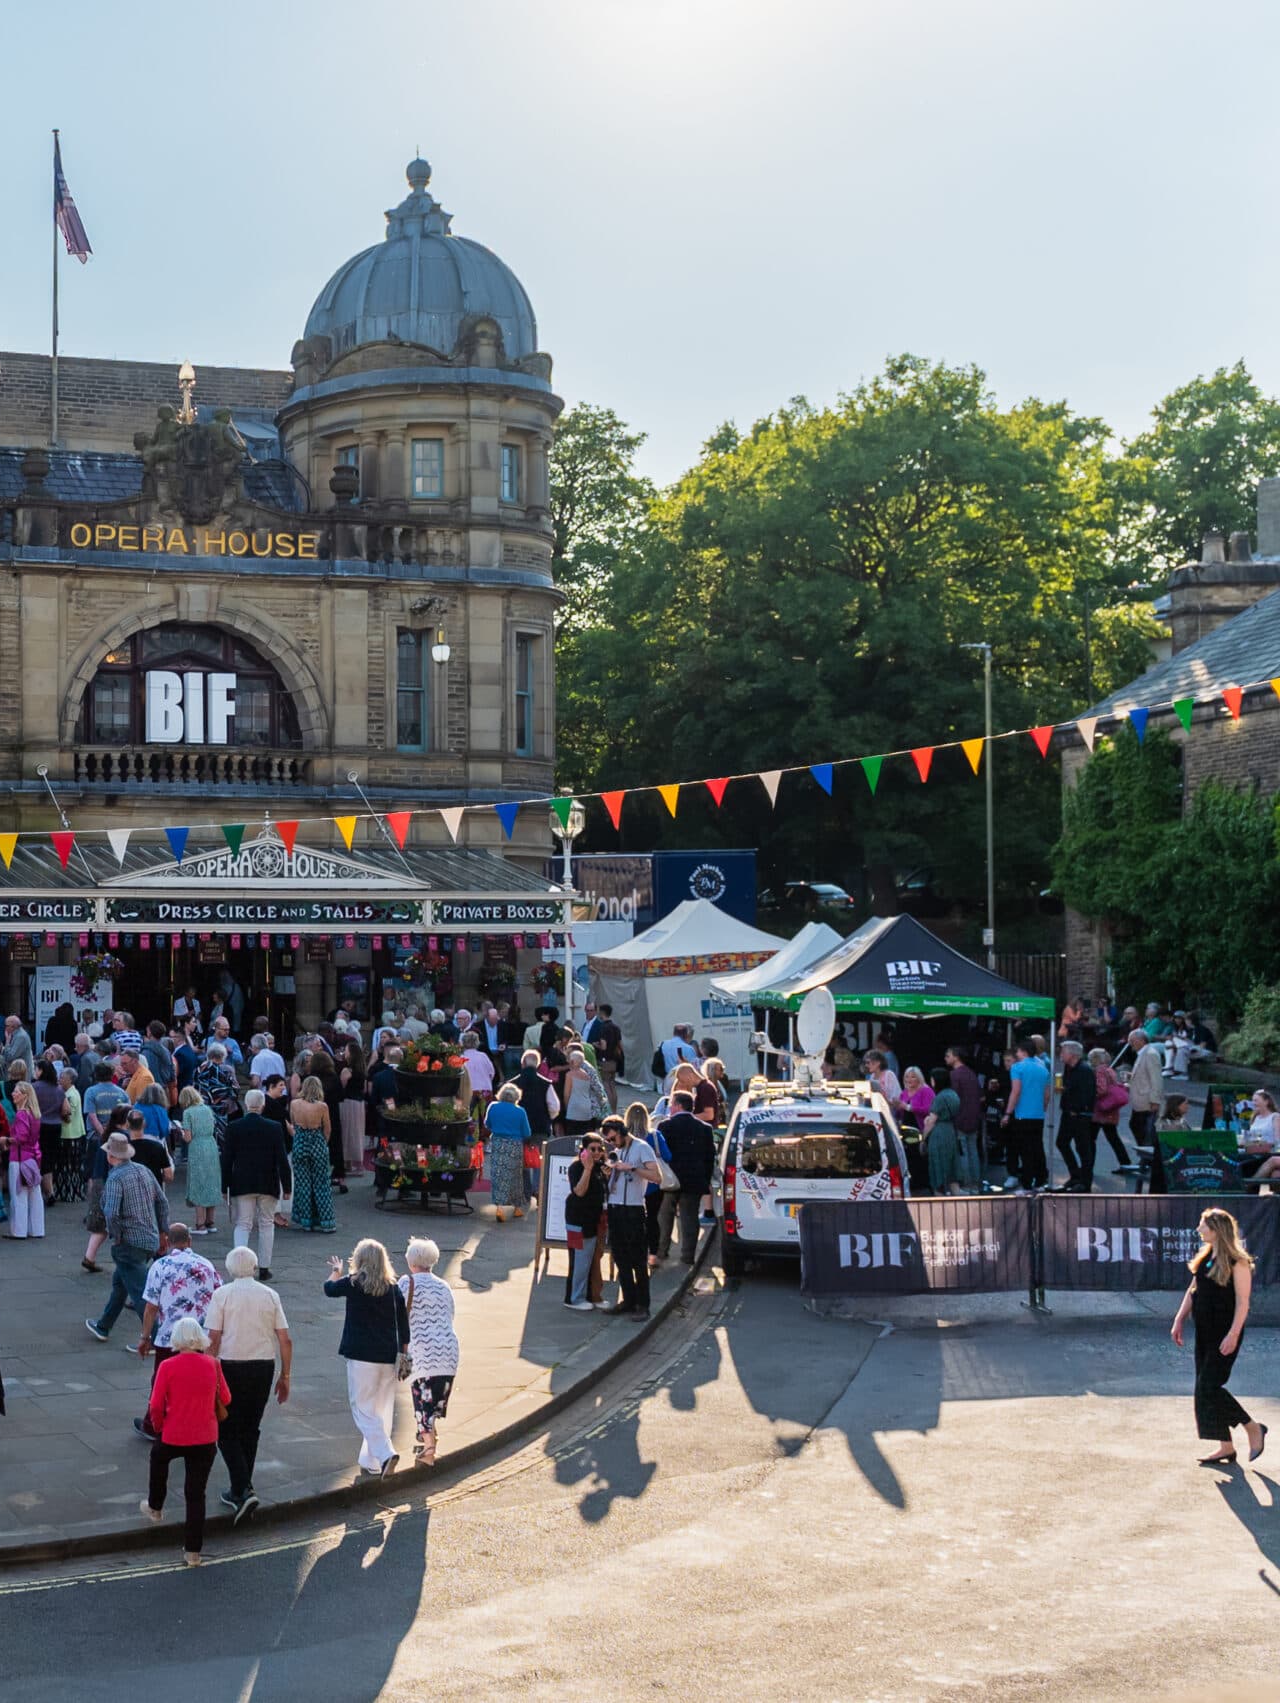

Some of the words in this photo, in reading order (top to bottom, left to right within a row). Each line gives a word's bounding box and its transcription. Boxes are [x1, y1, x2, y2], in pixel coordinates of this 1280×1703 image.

[70, 523, 189, 553] OPERA
[203, 530, 319, 558] HOUSE
[145, 670, 237, 745] BIF
[196, 851, 253, 877] OPERA
[283, 852, 337, 878] HOUSE
[26, 902, 82, 918] CIRCLE
[158, 903, 212, 919] DRESS
[216, 903, 277, 919] CIRCLE
[281, 907, 307, 918] AND
[310, 903, 373, 919] STALLS
[443, 905, 502, 920] PRIVATE
[507, 904, 554, 920] BOXES
[885, 959, 942, 977] BIF
[1161, 1227, 1201, 1238] Buxto
[838, 1232, 917, 1269] BIF
[1076, 1227, 1159, 1263] BIF
